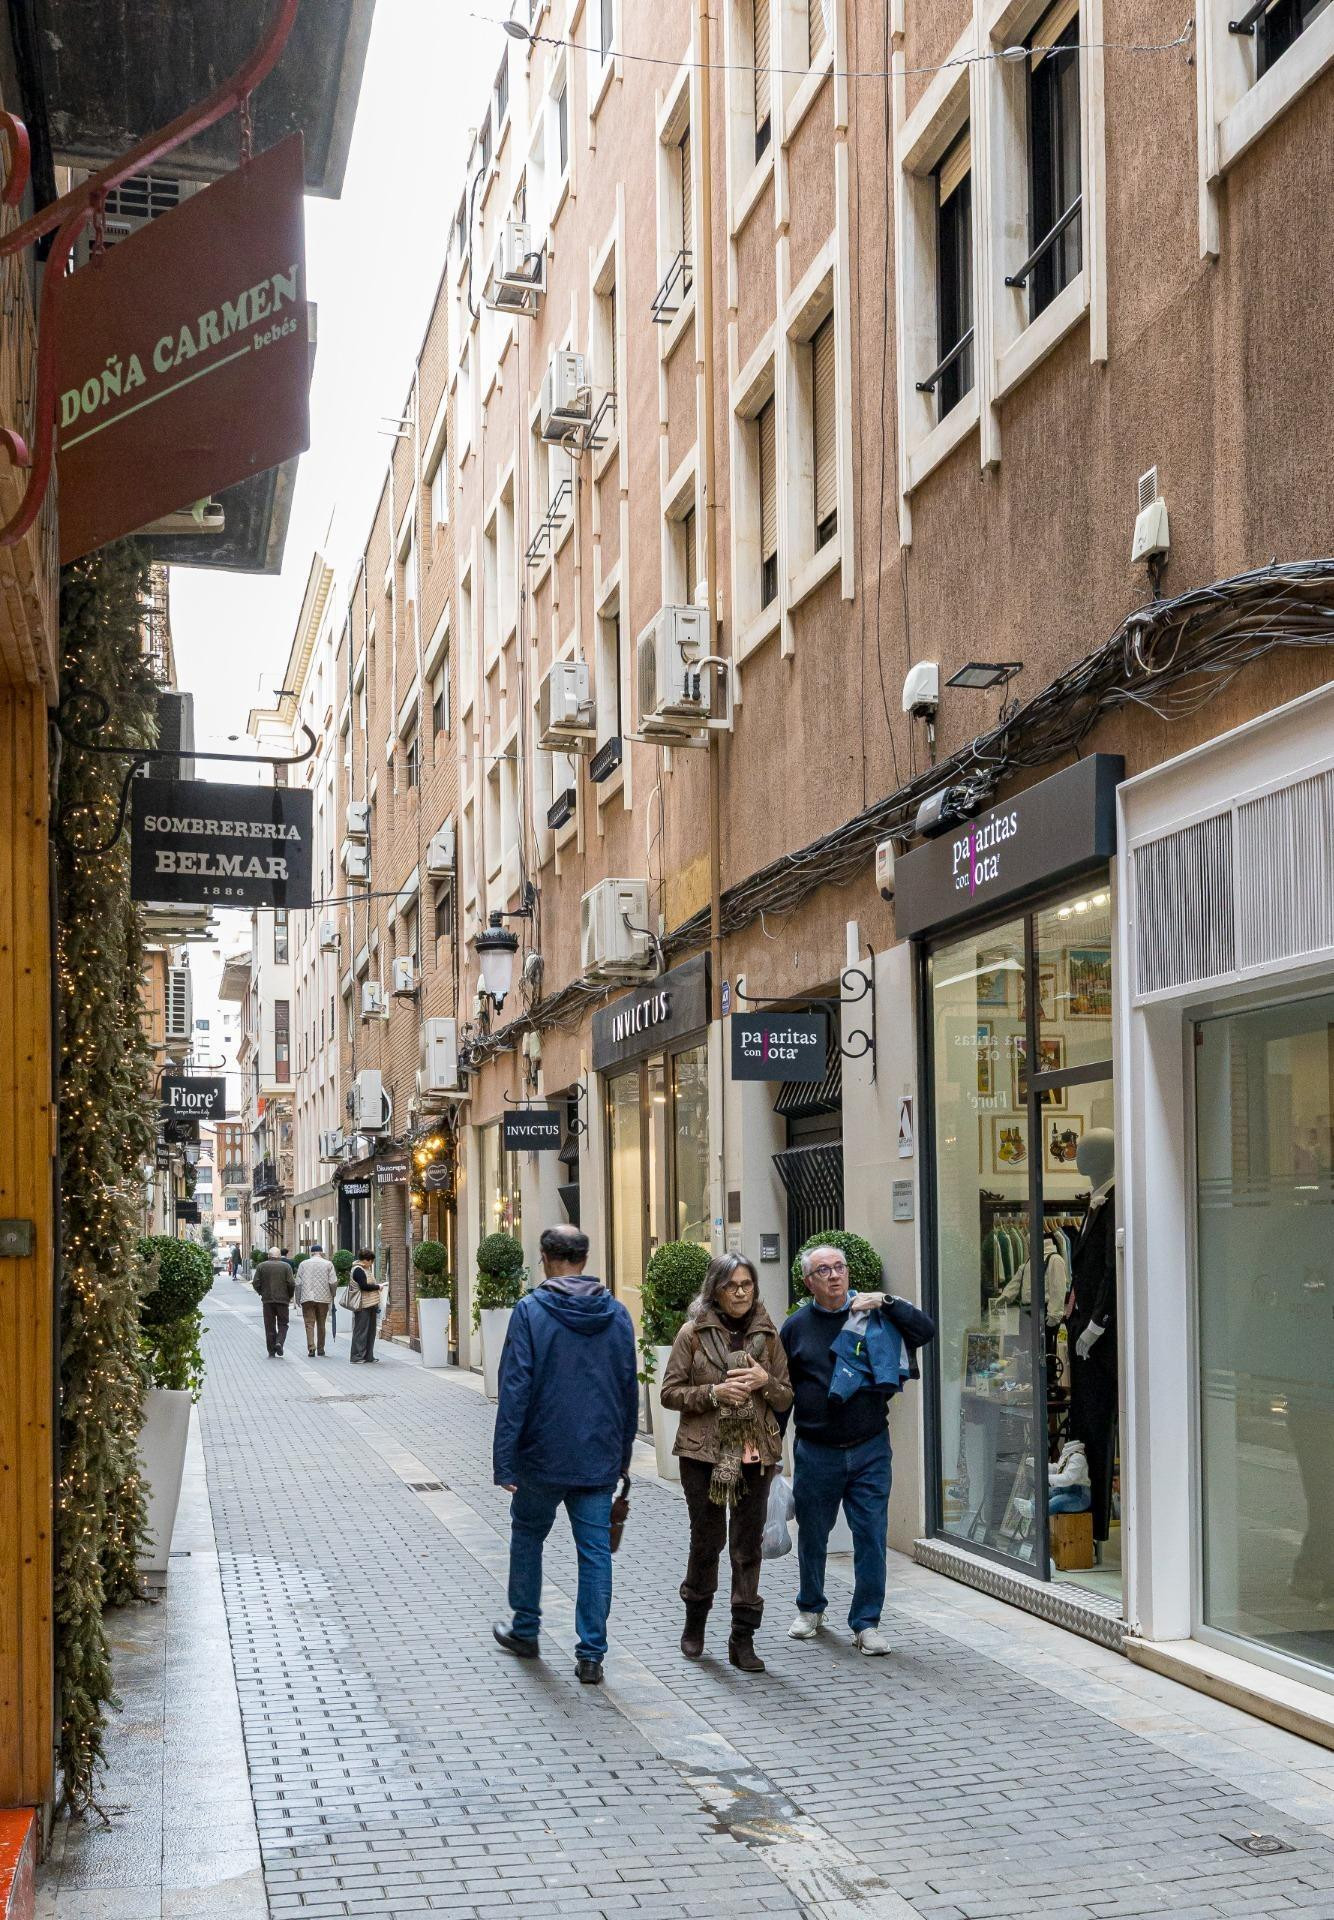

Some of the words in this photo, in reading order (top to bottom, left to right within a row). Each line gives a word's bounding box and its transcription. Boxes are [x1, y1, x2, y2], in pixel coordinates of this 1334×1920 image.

[61, 354, 147, 428] DOÑA
[153, 264, 299, 373] CARMEN
[254, 317, 297, 350] bebés
[144, 815, 302, 841] SOMBRERERIA
[953, 812, 1018, 875] pajaritas
[155, 850, 289, 880] BELMAR
[203, 887, 244, 896] 1886
[955, 873, 970, 889] con
[612, 991, 668, 1043] INVICTUS
[740, 1028, 817, 1048] pajaritas
[744, 1049, 761, 1057] con
[507, 1125, 559, 1137] INVICTUS
